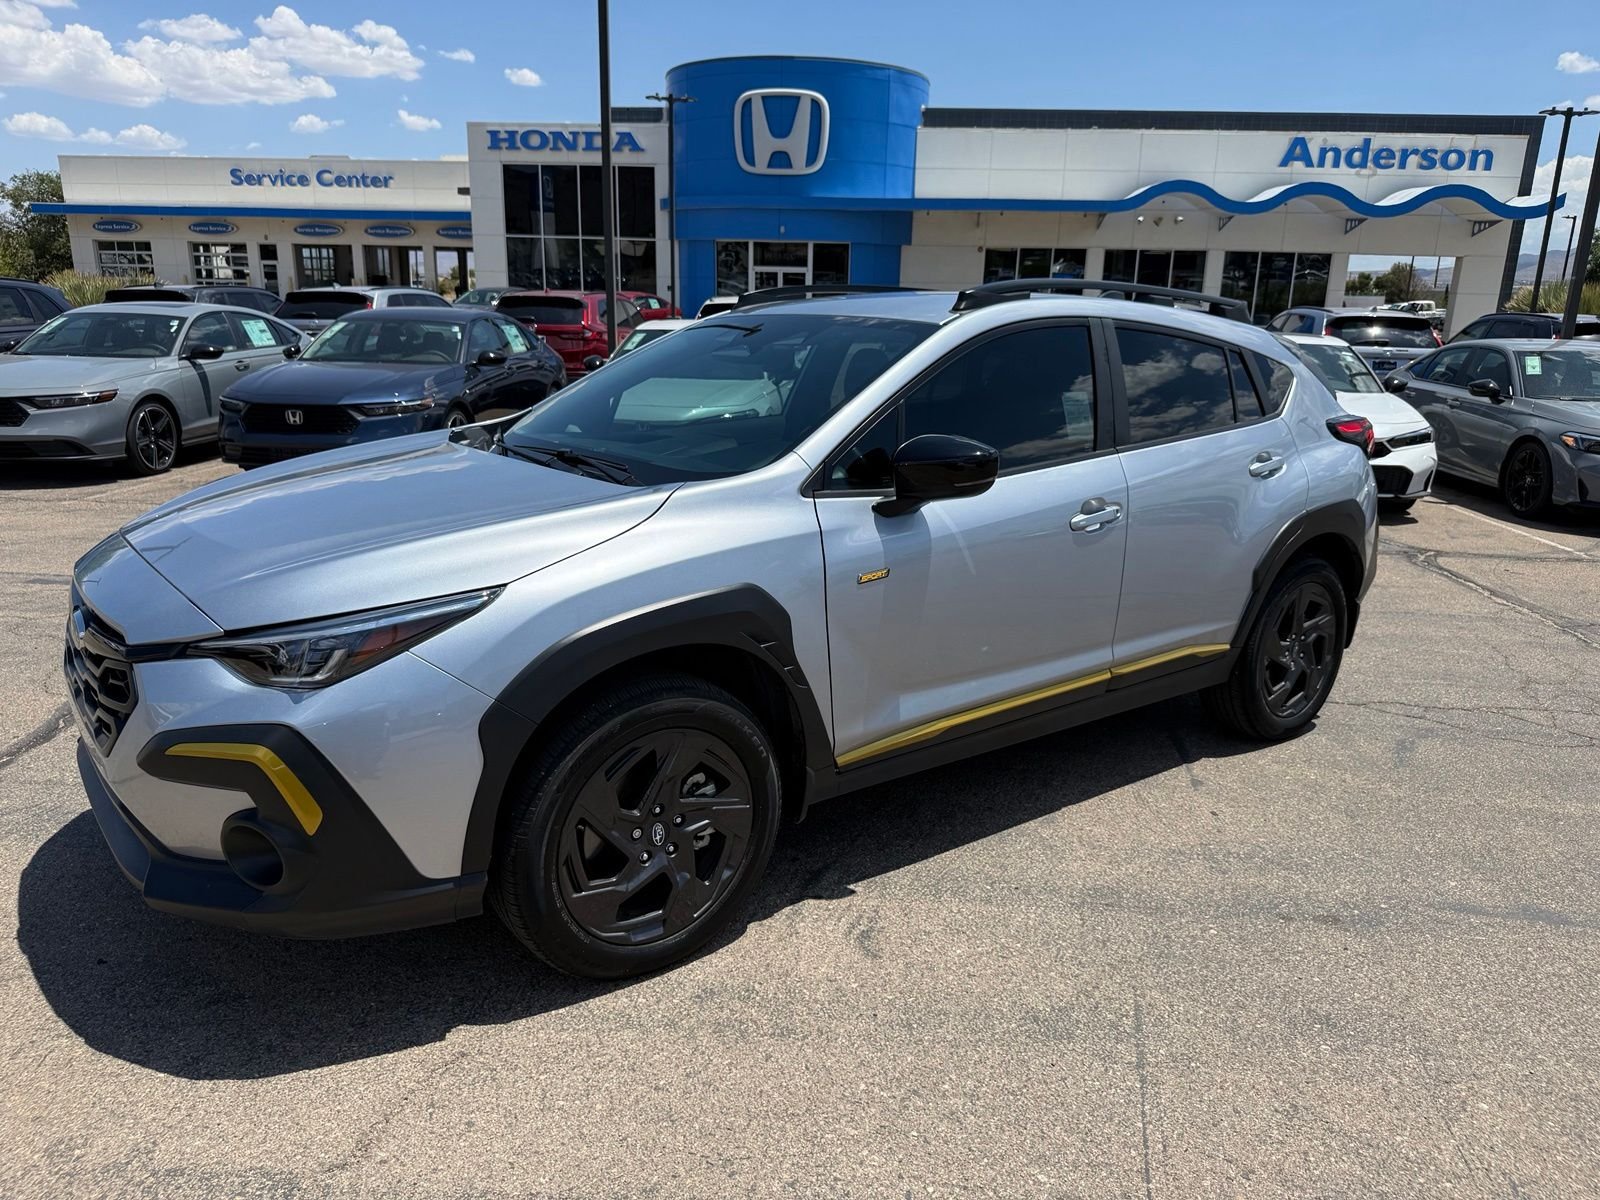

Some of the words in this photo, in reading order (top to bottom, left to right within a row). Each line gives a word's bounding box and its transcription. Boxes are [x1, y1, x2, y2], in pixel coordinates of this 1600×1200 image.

[486, 130, 645, 152] HONDA
[1279, 136, 1494, 171] Anderson
[229, 168, 311, 187] Service
[316, 169, 394, 188] Center
